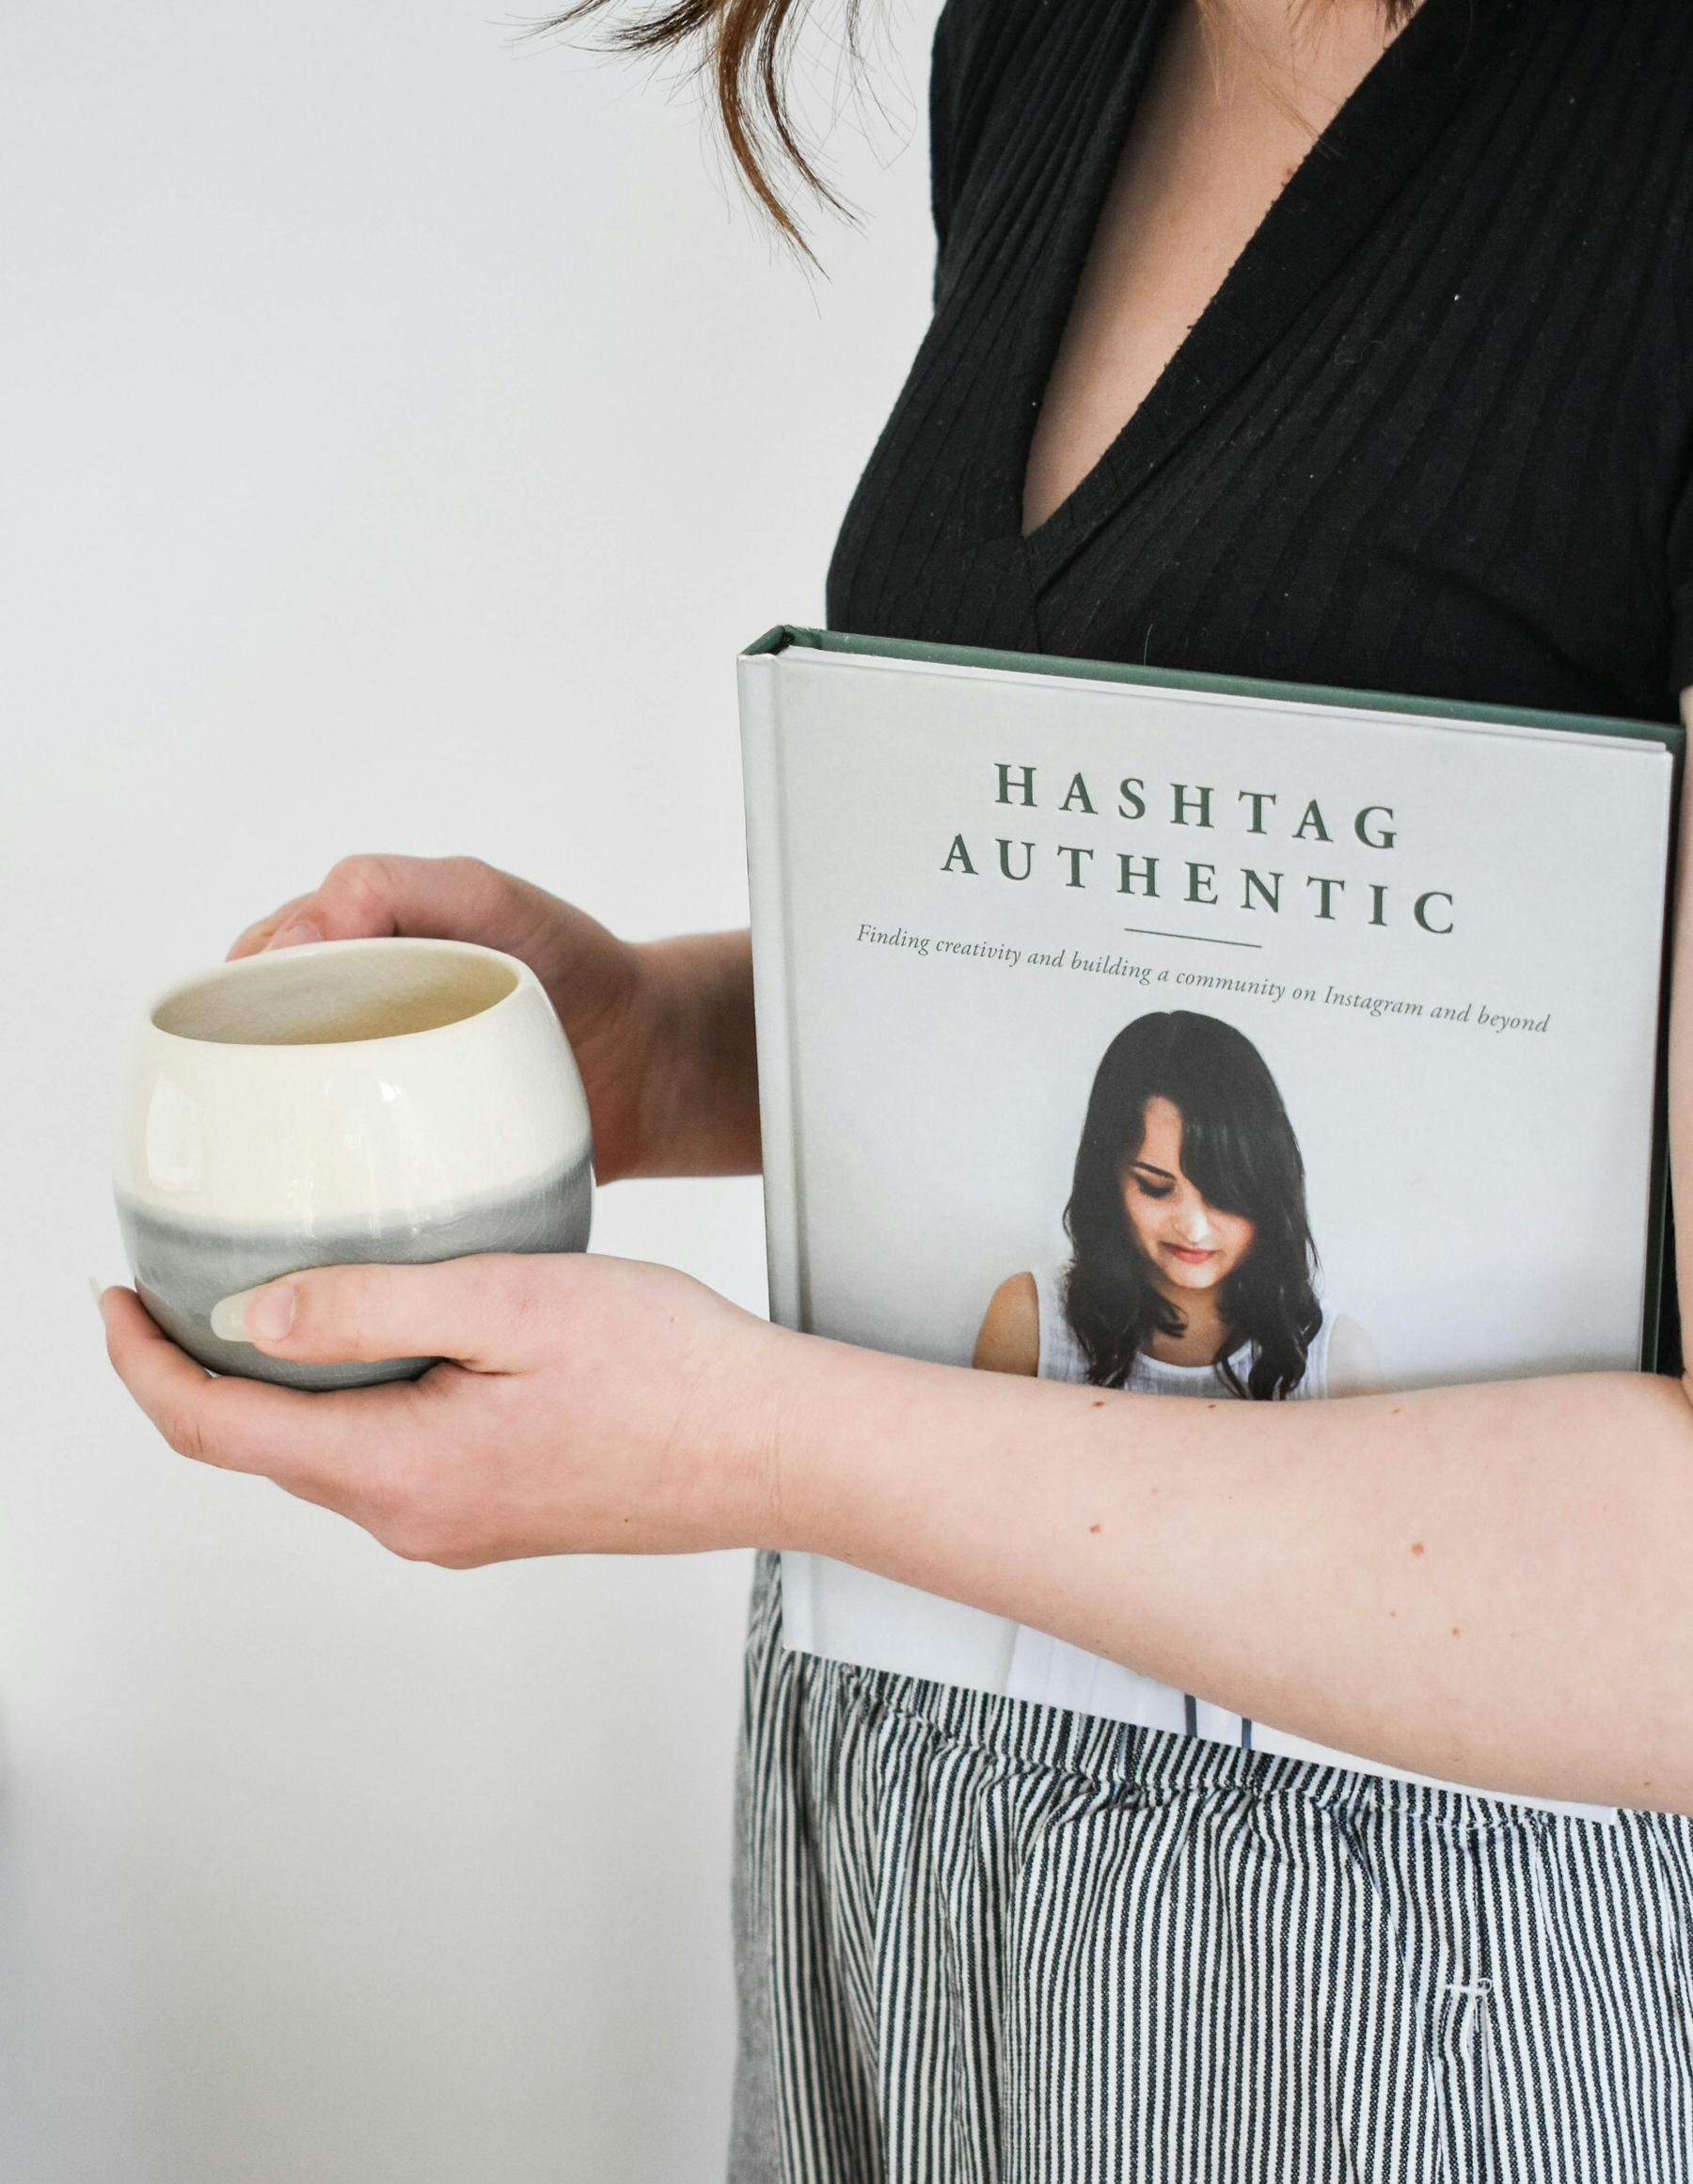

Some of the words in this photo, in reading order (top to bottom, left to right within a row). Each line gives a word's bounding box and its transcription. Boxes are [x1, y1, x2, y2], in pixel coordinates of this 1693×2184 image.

[993, 762, 1398, 850] HASHTAG
[939, 832, 1454, 935] AUTHENTIC
[857, 924, 931, 957] Finding
[935, 940, 1021, 968] creativity
[1026, 948, 1067, 968] and
[1070, 950, 1153, 986] building
[1157, 970, 1170, 983] a
[1176, 973, 1286, 1004] community
[1291, 988, 1317, 1003] on
[1323, 986, 1423, 1018] Instagram
[1430, 1003, 1473, 1022] and
[1477, 1005, 1552, 1034] beyond
